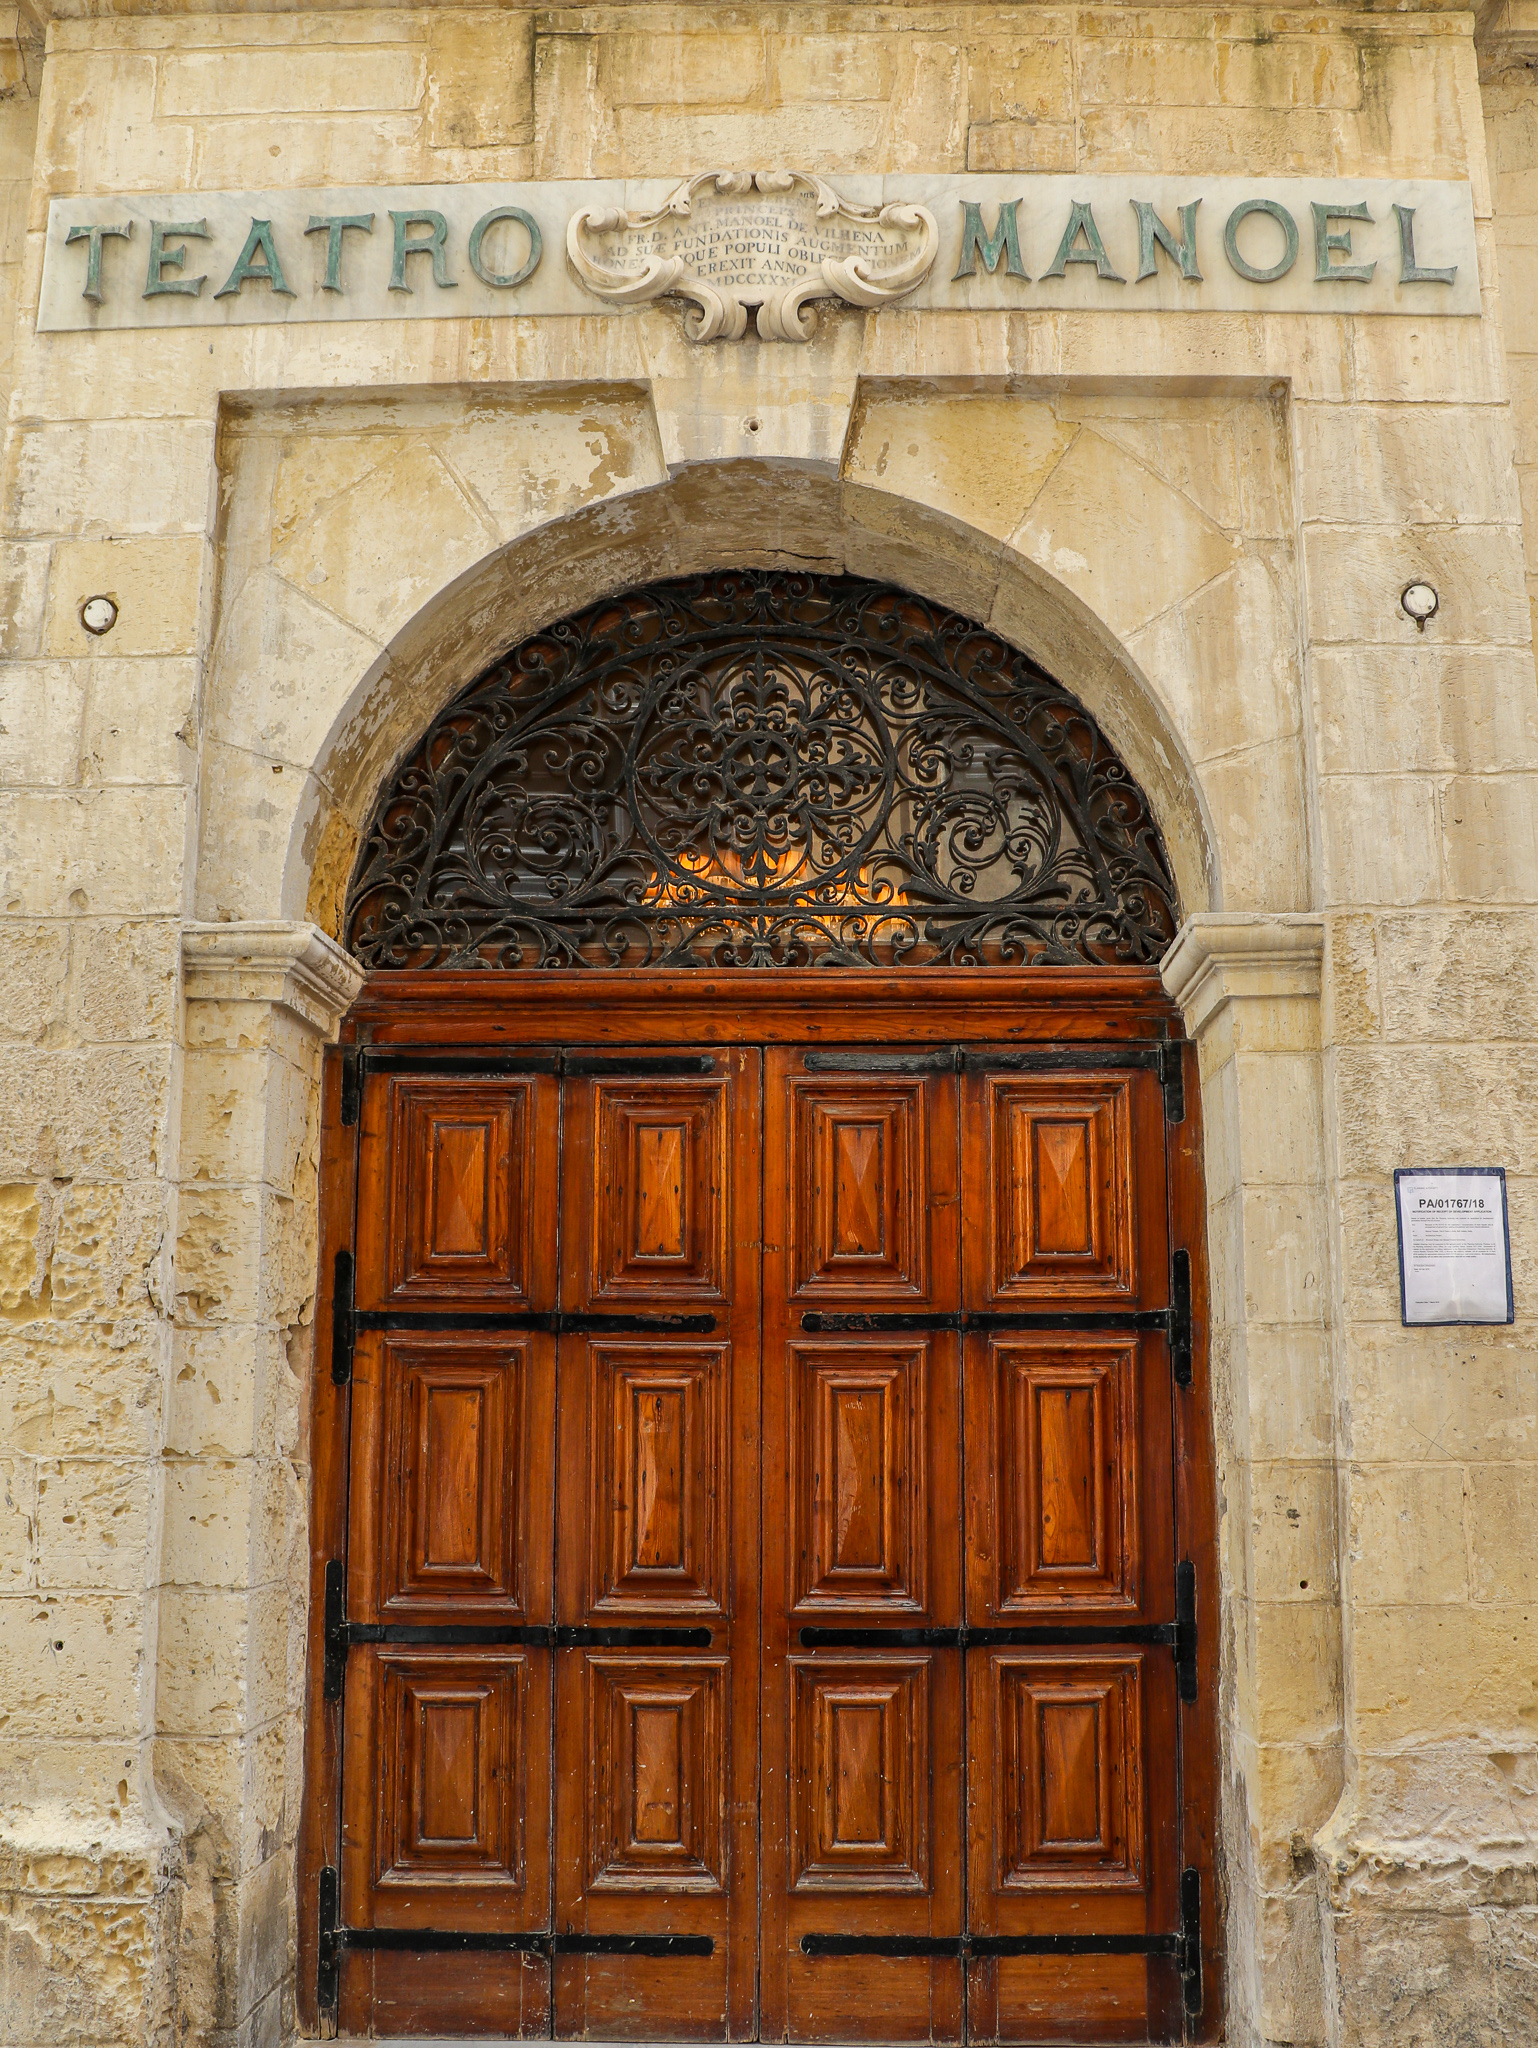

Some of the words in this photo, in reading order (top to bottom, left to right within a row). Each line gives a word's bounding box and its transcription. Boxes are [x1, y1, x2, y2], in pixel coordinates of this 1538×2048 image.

[716, 216, 782, 229] MANOEL
[788, 220, 808, 233] DE
[813, 226, 886, 243] VILHENA
[65, 205, 543, 299] TEATRO
[950, 197, 1458, 287] MANOEL
[606, 246, 629, 257] AD
[673, 228, 789, 251] FUNDATIONIS
[796, 236, 908, 257] AUGMENTUM
[724, 242, 781, 256] POPULI
[697, 258, 757, 277] EREXIT
[761, 259, 807, 276] ANNO
[1418, 1199, 1485, 1209] PA/01767/18
